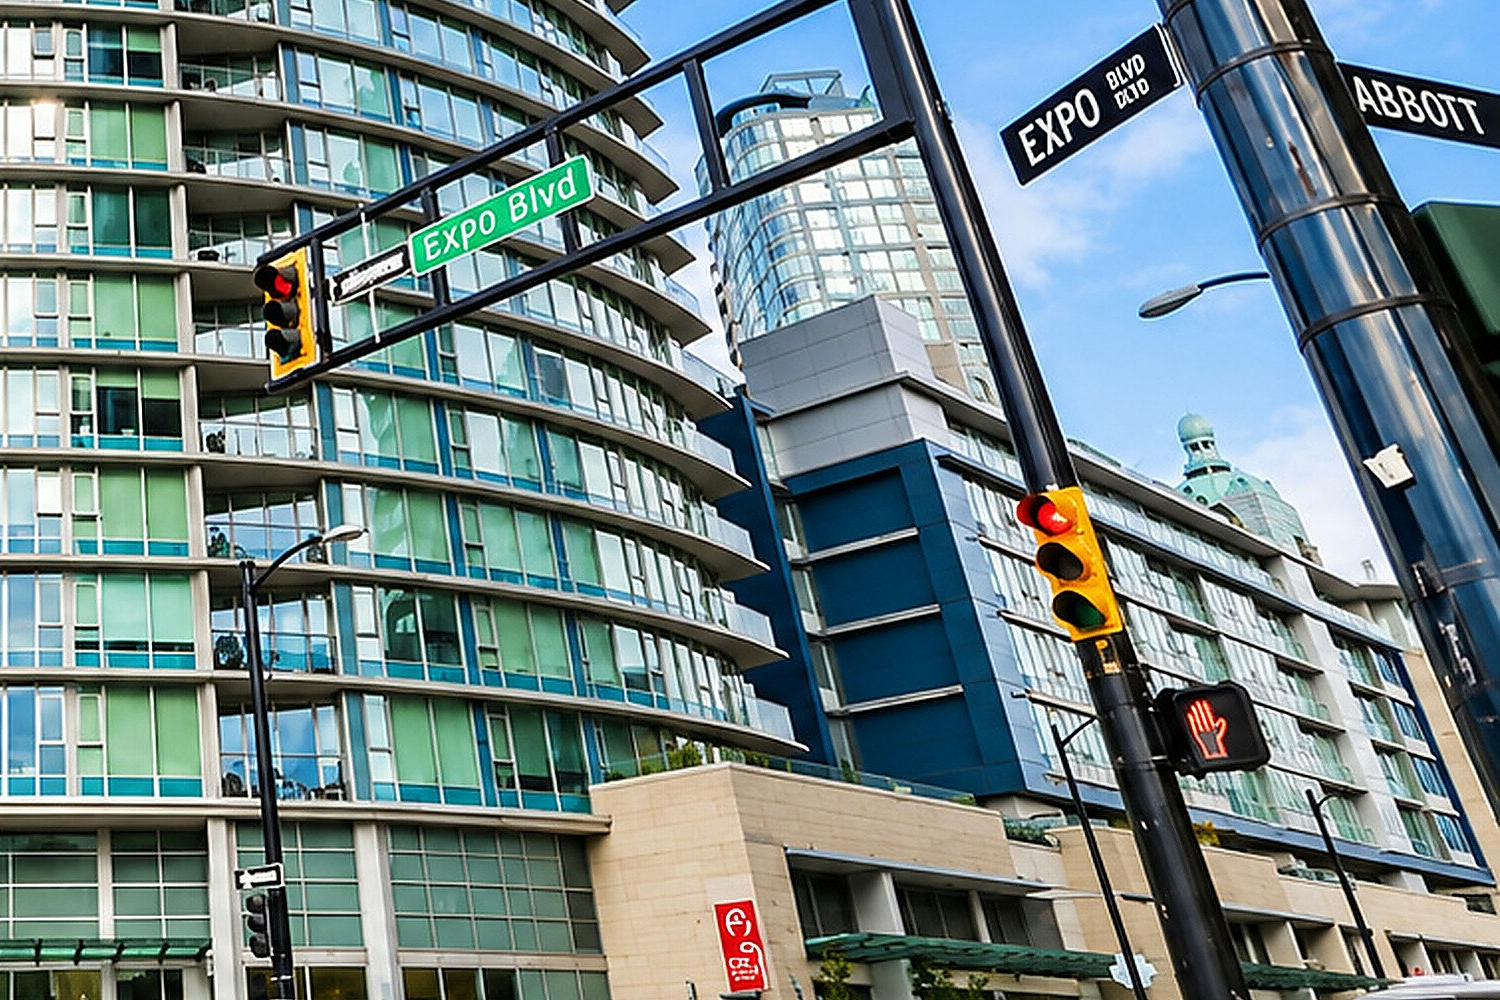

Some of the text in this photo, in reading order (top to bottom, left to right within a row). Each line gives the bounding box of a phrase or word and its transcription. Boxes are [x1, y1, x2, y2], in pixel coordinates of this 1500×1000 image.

[1017, 53, 1147, 168] EXPO BLVD
[1352, 75, 1486, 136] ABBOTT
[422, 166, 578, 262] Expo Blvd
